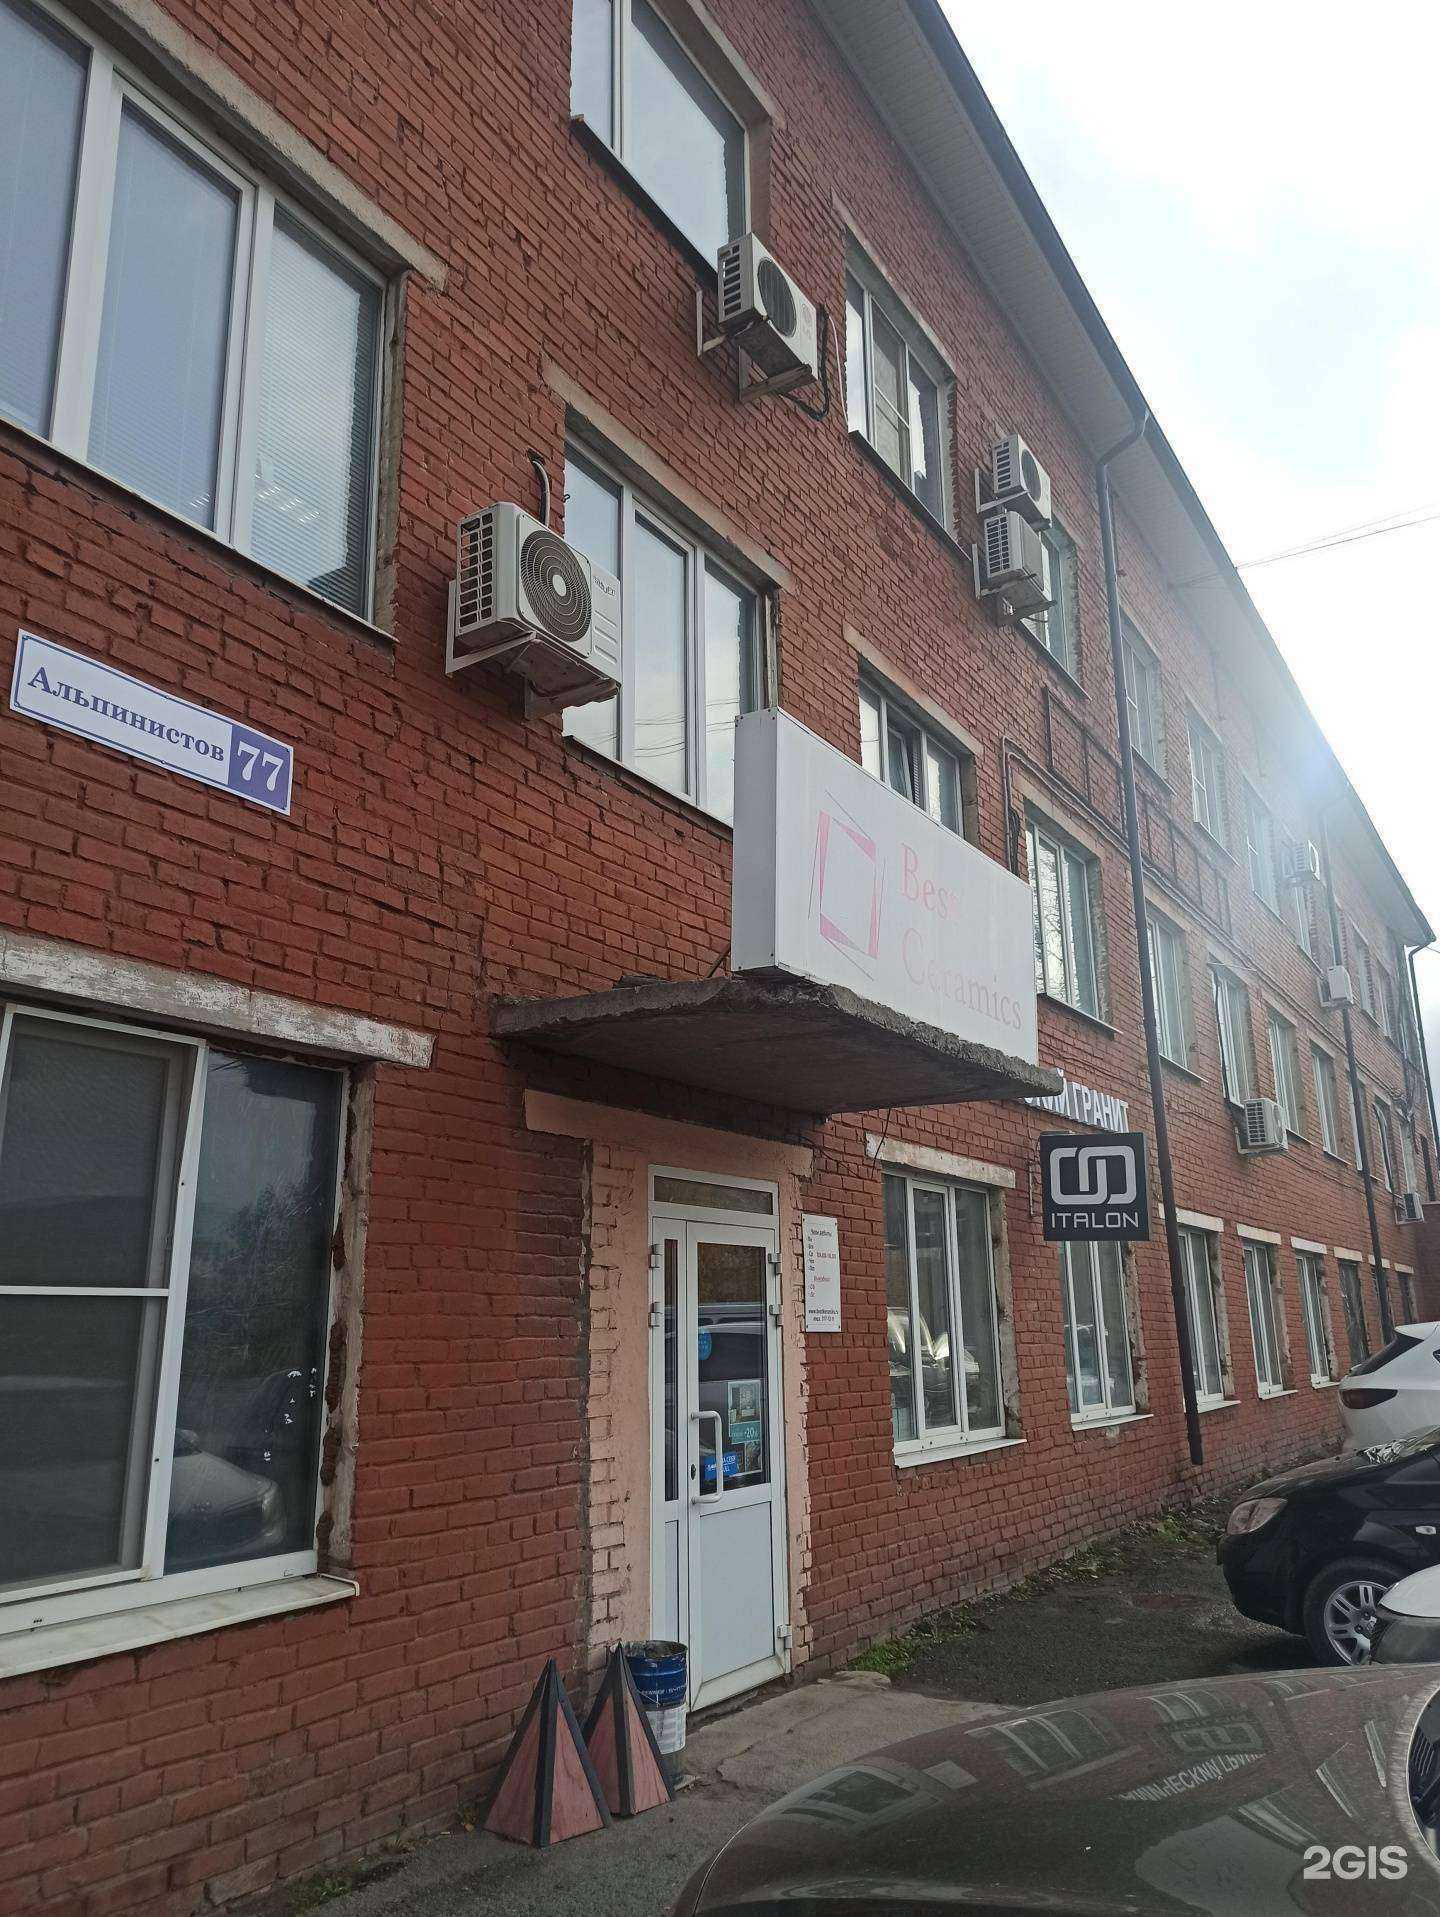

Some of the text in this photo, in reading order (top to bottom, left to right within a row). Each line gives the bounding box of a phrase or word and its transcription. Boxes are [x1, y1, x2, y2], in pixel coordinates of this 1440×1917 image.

[27, 666, 284, 792] Альпинистов 77
[901, 842, 957, 922] Bes
[902, 927, 1022, 1031] Ceramics
[1072, 1081, 1130, 1133] ГРАНИТ
[1051, 1211, 1139, 1229] ITALON
